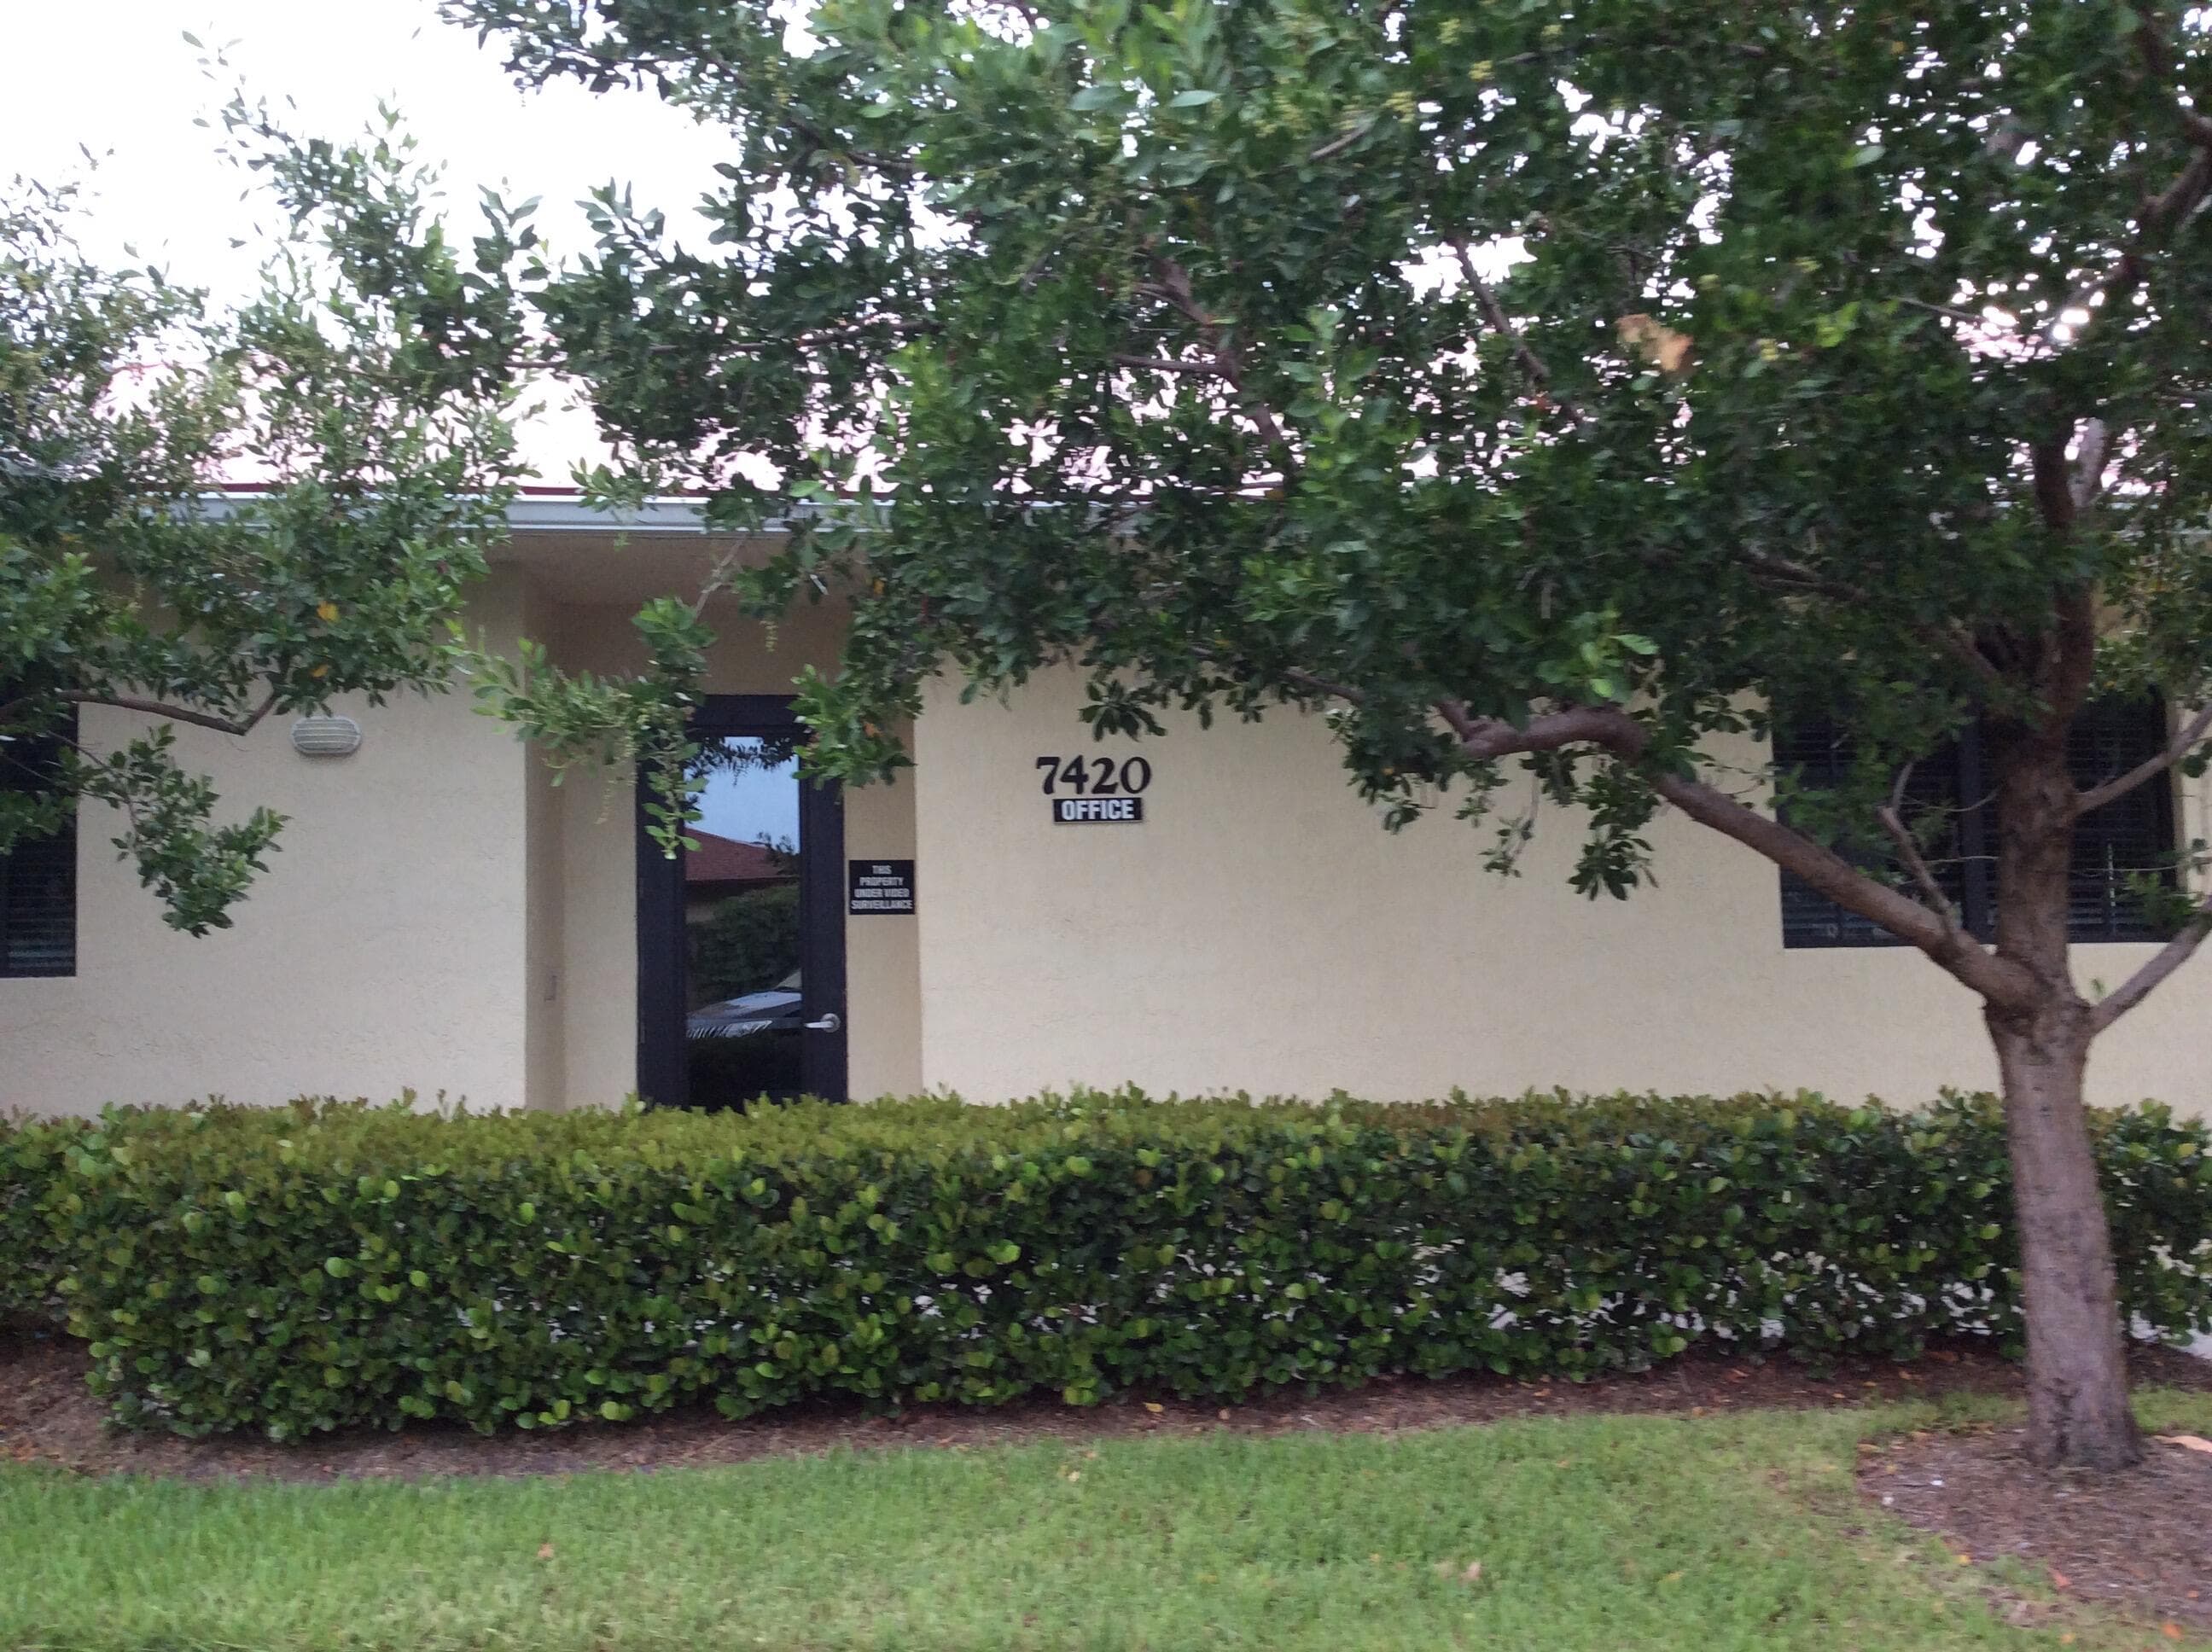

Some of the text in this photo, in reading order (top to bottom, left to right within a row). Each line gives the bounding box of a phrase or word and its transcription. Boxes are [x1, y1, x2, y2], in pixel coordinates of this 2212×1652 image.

[1035, 754, 1152, 794] 7420
[1061, 800, 1135, 820] OFFICE
[872, 864, 892, 875] THIS
[859, 876, 904, 887] PROPERTY
[854, 888, 910, 898] UNDER VIDEO
[851, 899, 913, 910] SURVEILLANCE
